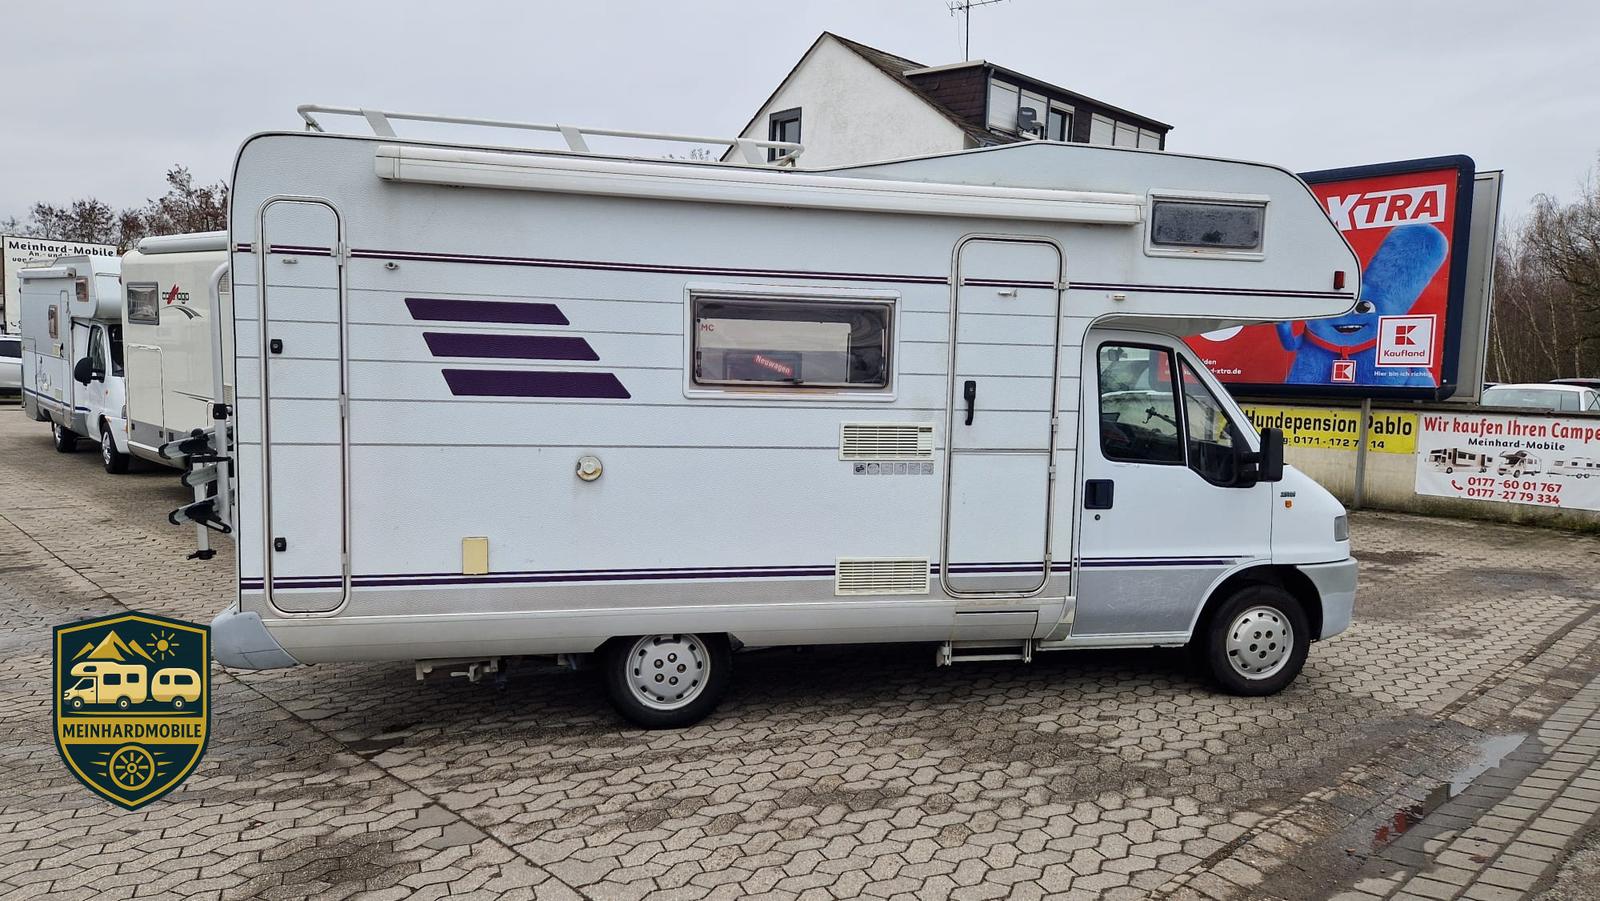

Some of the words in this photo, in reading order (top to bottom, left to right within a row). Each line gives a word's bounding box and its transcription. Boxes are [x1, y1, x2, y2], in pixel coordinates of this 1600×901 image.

[9, 241, 114, 257] Meinhard-Mobile
[1384, 349, 1425, 358] Kaufland
[755, 354, 791, 375] Neuwagen
[1246, 410, 1357, 434] Hundepension
[1424, 416, 1449, 432] Wir
[1453, 418, 1503, 437] kaufen
[1508, 420, 1546, 437] Ihren
[1294, 436, 1320, 445] 0171
[1330, 438, 1349, 447] 172
[1371, 441, 1385, 449] 14
[1468, 438, 1565, 451] Meinhard-Mobile
[1468, 476, 1495, 487] 0177
[1523, 483, 1537, 491] 01
[1541, 483, 1562, 493] 767
[1467, 487, 1494, 498] 0177
[1520, 493, 1534, 502] 79
[1537, 494, 1560, 505] 334
